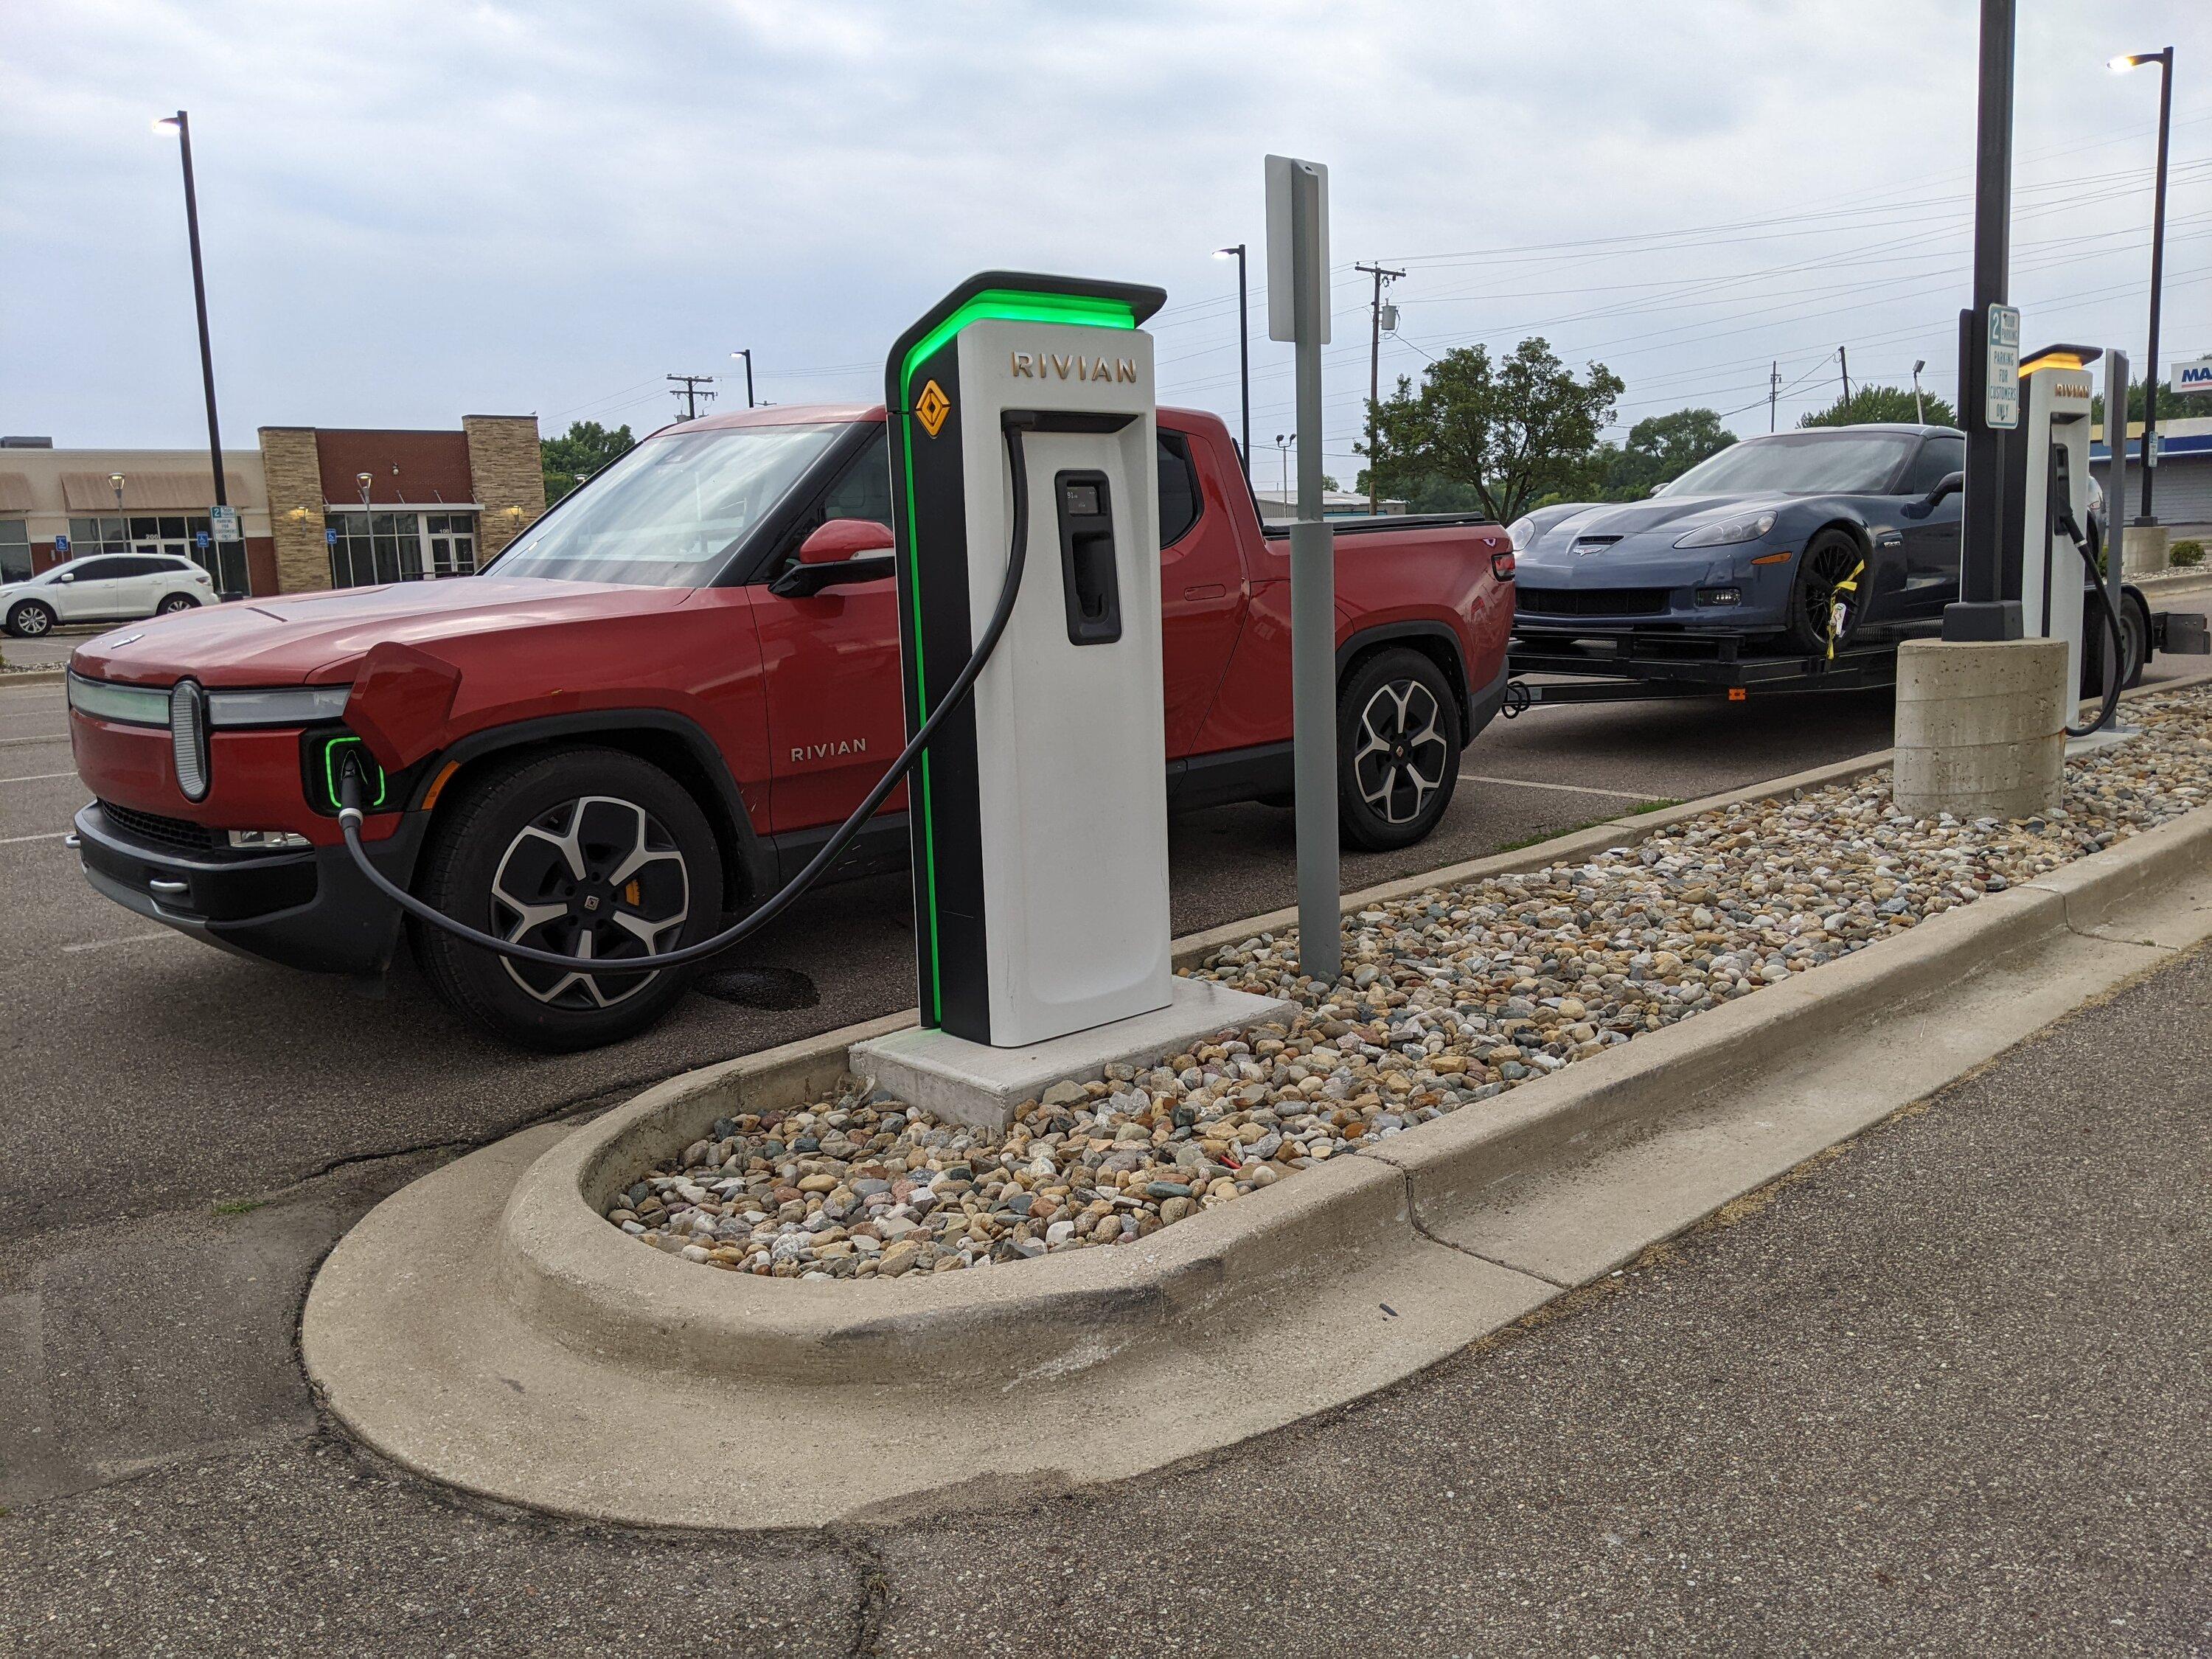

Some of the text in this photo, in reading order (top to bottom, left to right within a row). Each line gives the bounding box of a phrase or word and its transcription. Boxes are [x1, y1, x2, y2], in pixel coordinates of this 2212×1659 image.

[1992, 312, 1999, 339] 2
[1994, 350, 2014, 366] PARKING
[1012, 350, 1138, 383] RIVIAN
[1999, 369, 2008, 383] FOR
[1990, 386, 2017, 401] CUSTOMERS
[2055, 383, 2090, 398] RIVIAN
[1996, 403, 2009, 418] ONLY
[214, 508, 220, 517] 2
[790, 737, 867, 762] RIVIAN
